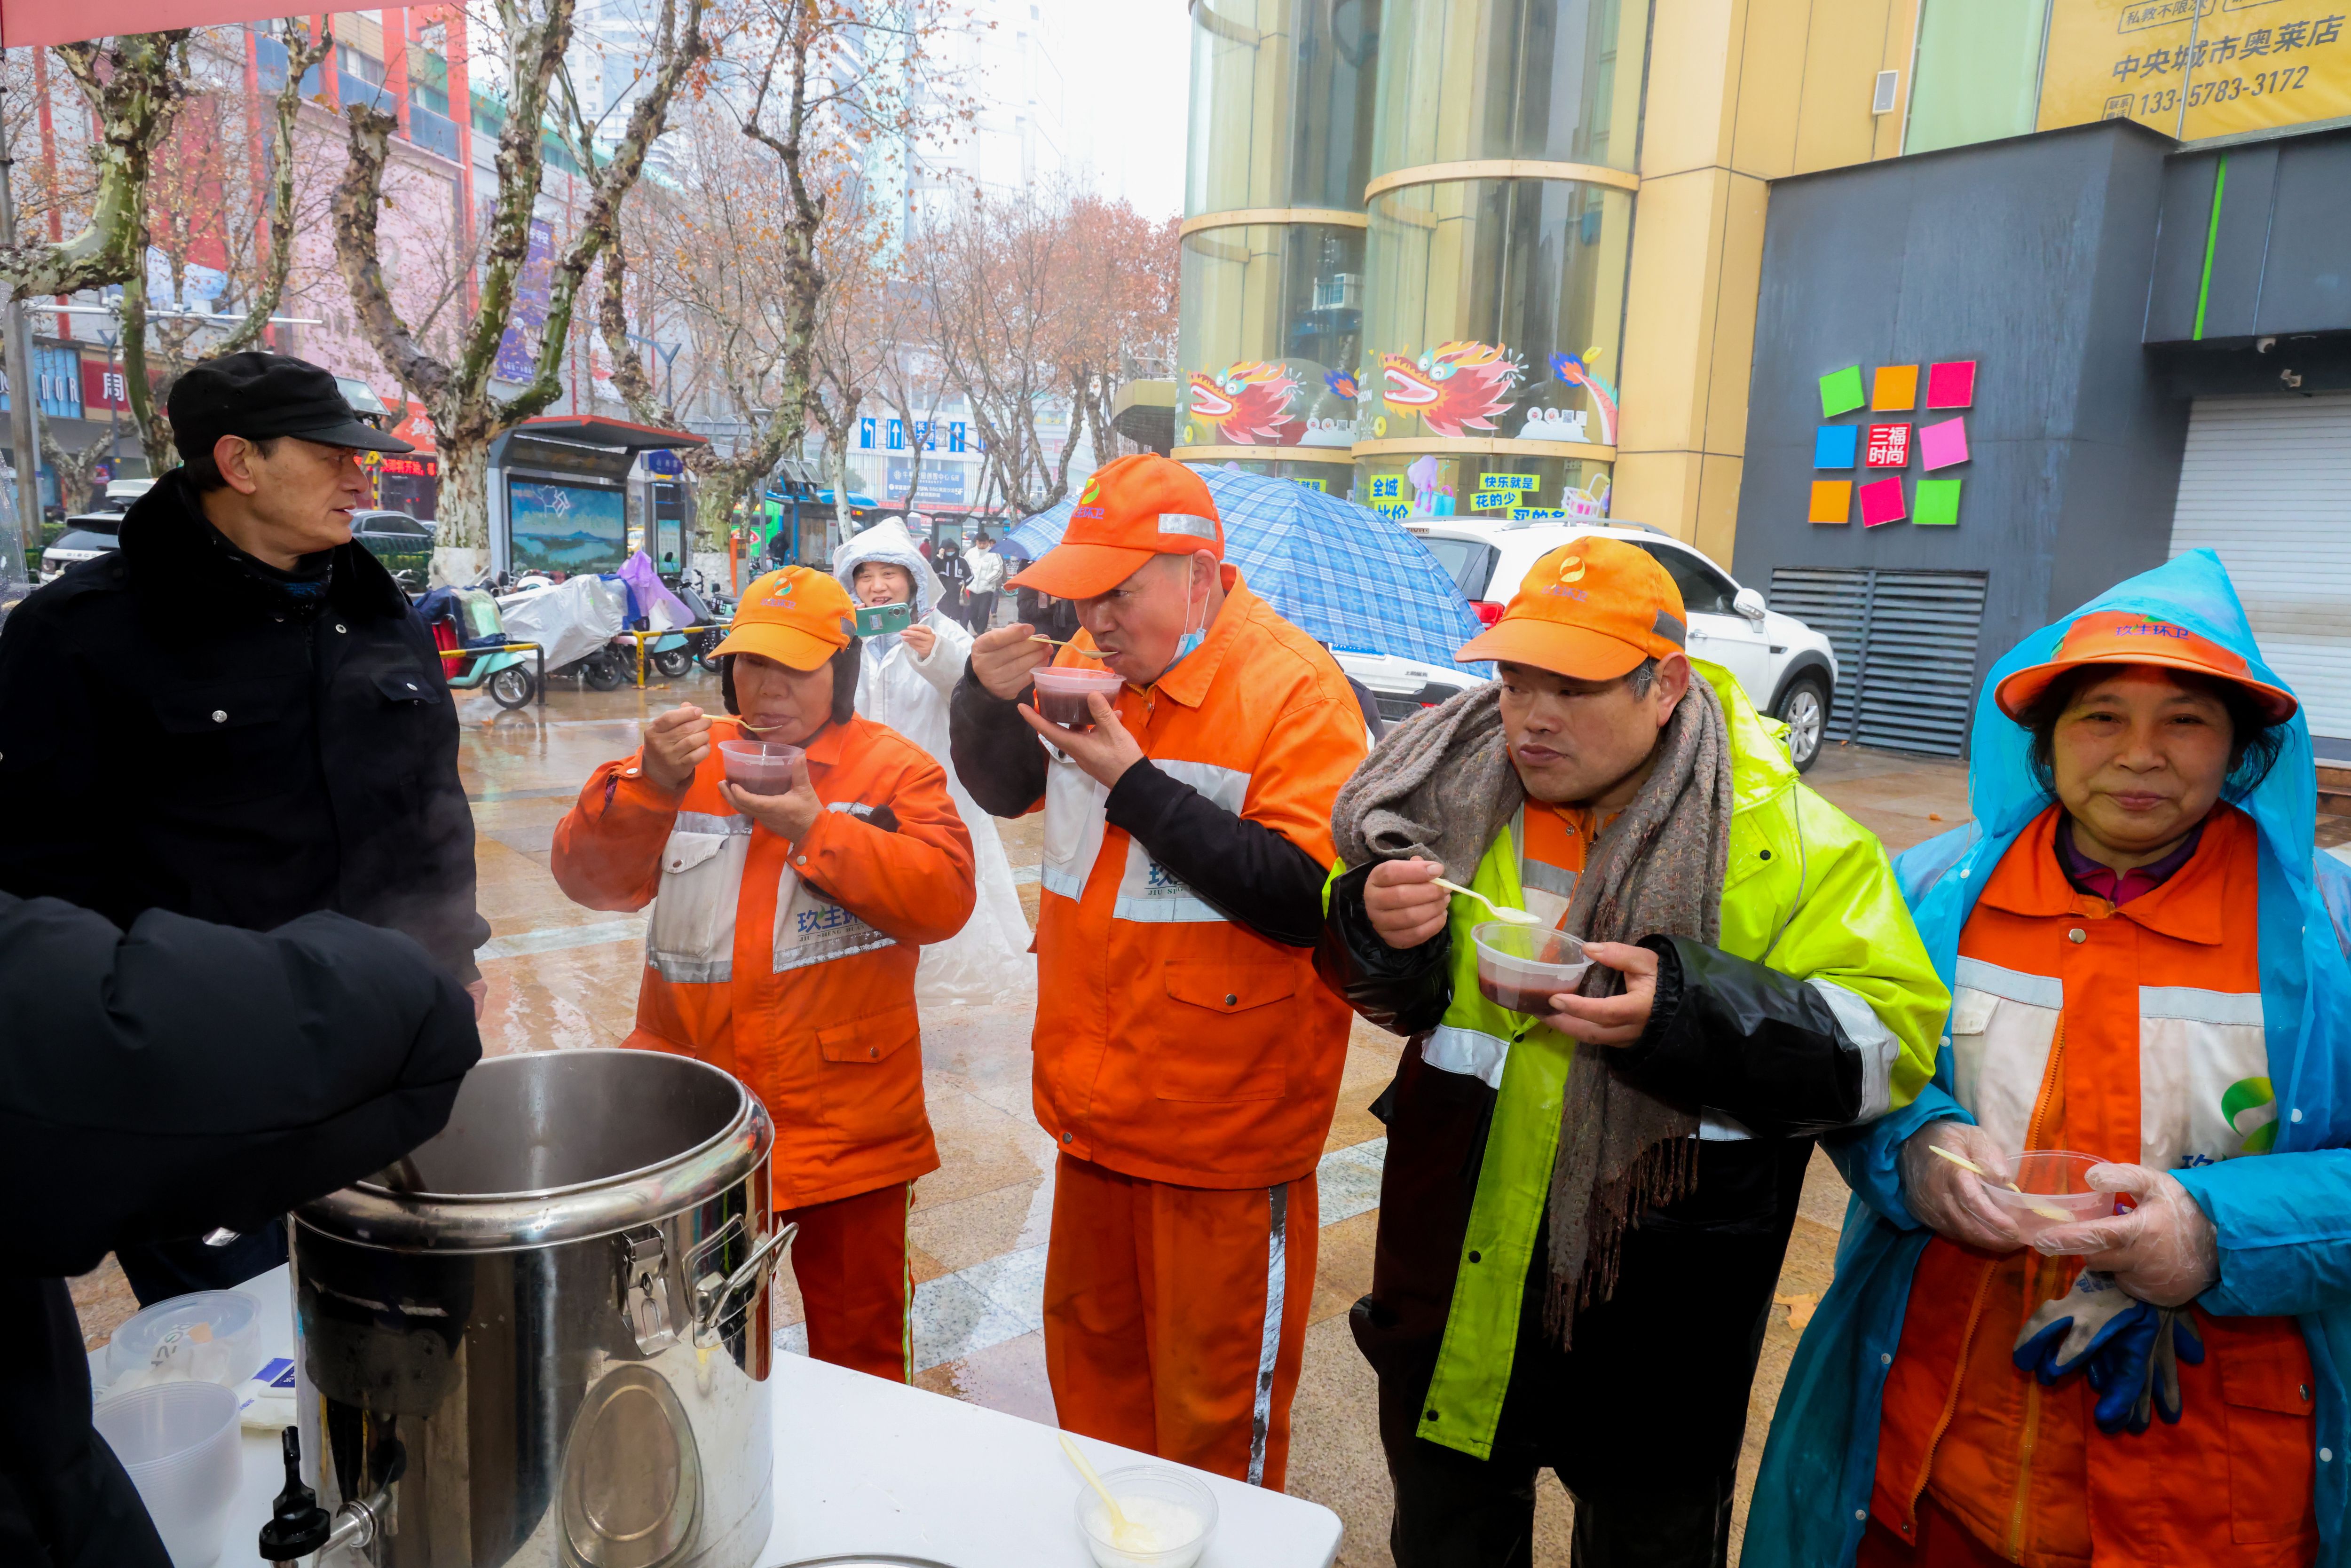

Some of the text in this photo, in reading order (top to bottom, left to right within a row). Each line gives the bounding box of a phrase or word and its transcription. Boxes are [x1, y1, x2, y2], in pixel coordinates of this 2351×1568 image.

[2112, 15, 2346, 82] 中央城市奥莱店
[2141, 65, 2310, 115] 133-5783-3172
[103, 372, 125, 402] 周
[1870, 426, 1908, 445] 三福
[1869, 445, 1905, 464] 时尚
[1373, 478, 1398, 497] 全城
[1485, 476, 1533, 489] 快乐就是
[1476, 492, 1516, 508] 花的少
[1074, 507, 1104, 520] 生环卫
[817, 929, 842, 938] SHENG
